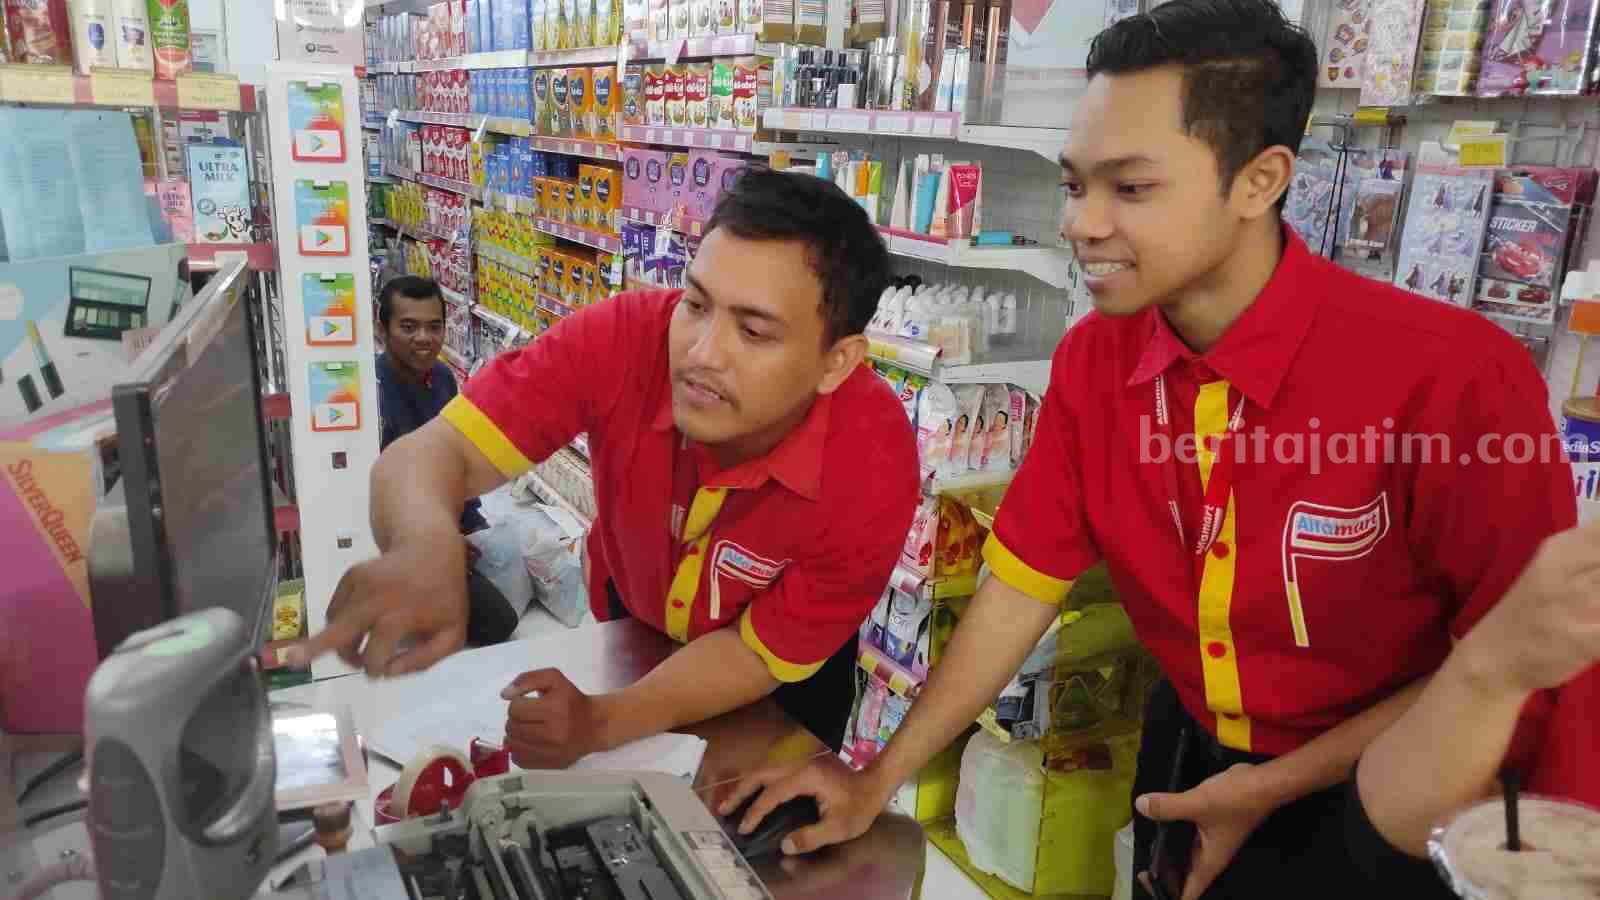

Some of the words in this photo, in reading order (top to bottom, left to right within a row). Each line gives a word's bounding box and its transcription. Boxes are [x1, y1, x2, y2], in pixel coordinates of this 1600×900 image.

[199, 160, 239, 173] ULTRA
[1489, 216, 1537, 233] STICKER
[1296, 513, 1378, 536] Alfamart
